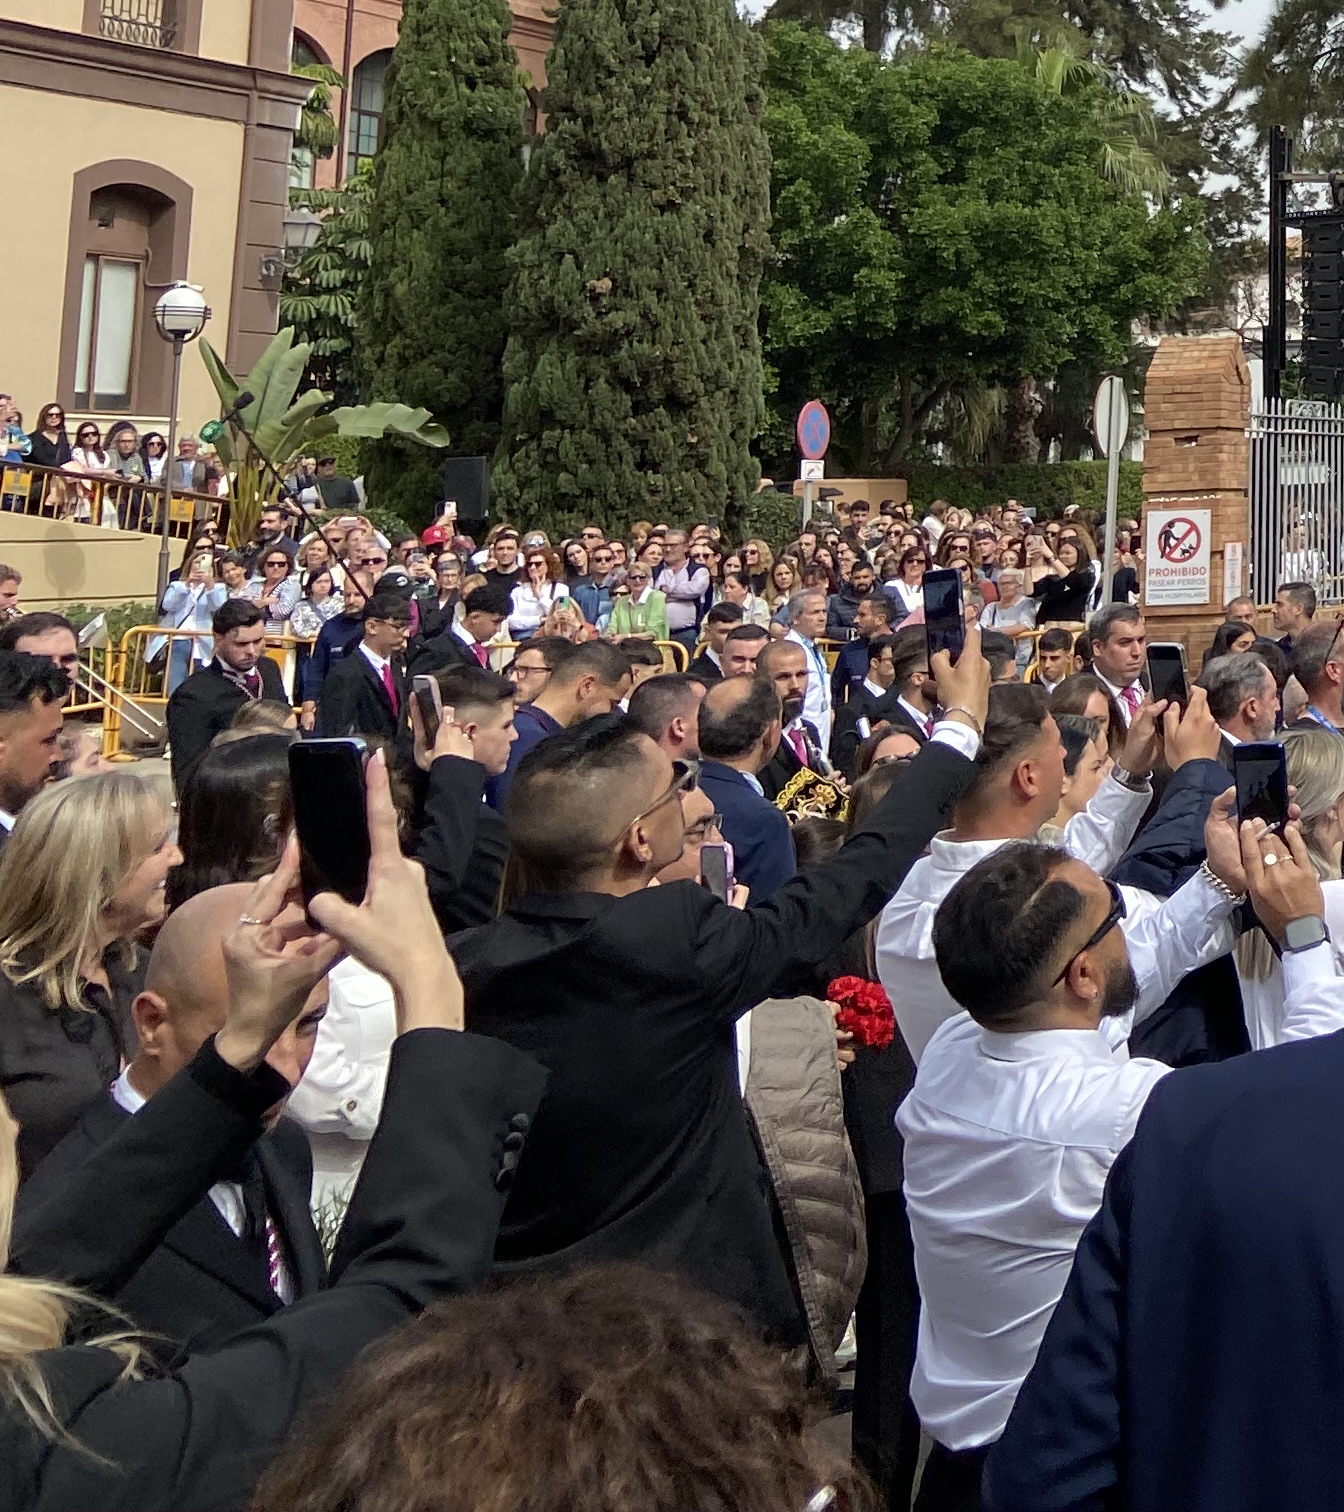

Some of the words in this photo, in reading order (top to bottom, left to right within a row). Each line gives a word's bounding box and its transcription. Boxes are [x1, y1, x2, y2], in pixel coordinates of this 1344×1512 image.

[1148, 567, 1207, 577] PROHIBIDO
[1148, 579, 1176, 587] PASEAR
[1177, 578, 1207, 586] PERROS
